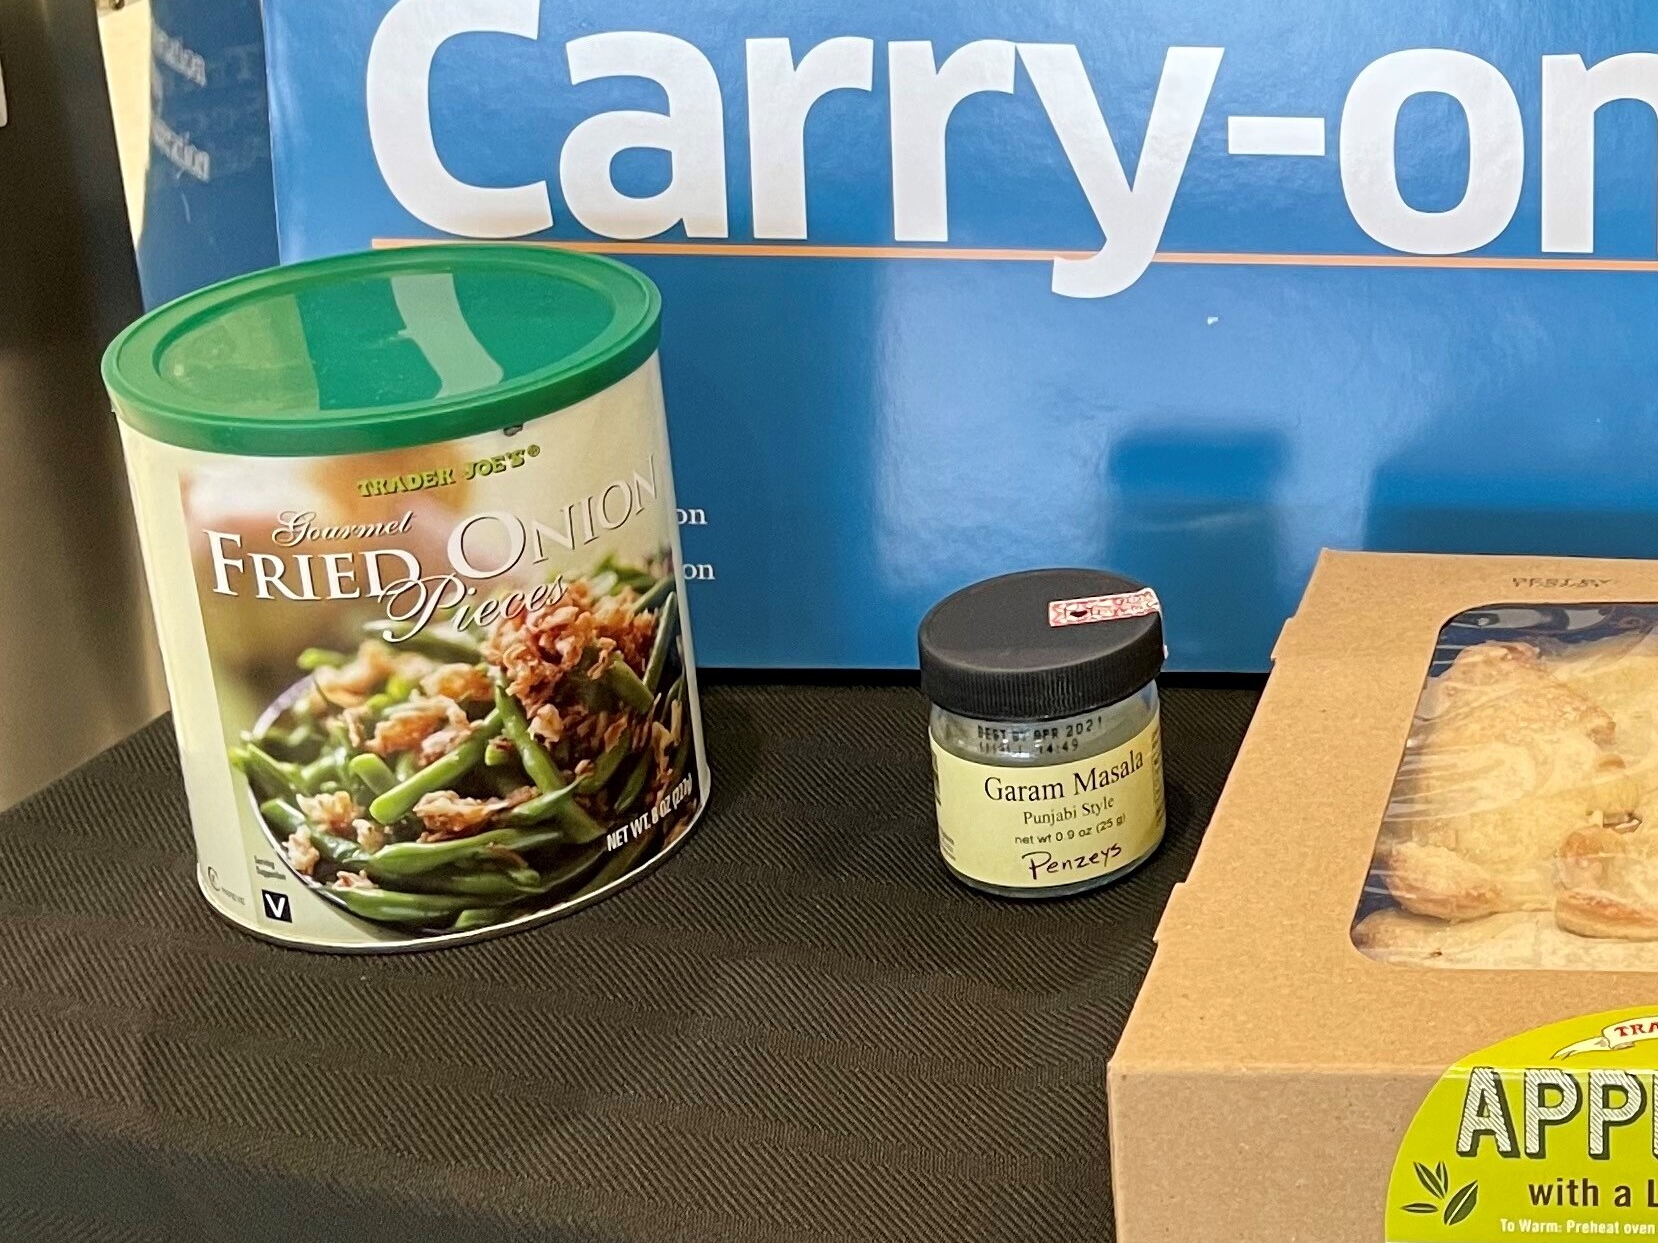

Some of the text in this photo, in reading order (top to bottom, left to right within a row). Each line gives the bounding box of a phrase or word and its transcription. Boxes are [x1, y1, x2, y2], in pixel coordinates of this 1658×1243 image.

[357, 468, 455, 498] TRADER
[202, 453, 659, 601] FRIED ONION
[271, 510, 417, 548] Gourmet
[377, 571, 570, 643] Pieces
[1033, 727, 1058, 740] APR
[984, 776, 1065, 801] Garam
[1073, 750, 1144, 796] Masala
[1023, 796, 1115, 826] Punjabi Style
[606, 825, 628, 852] NET
[630, 812, 651, 839] WT.
[1015, 834, 1034, 844] net
[1037, 834, 1052, 843] wt
[1078, 827, 1092, 837] oz
[1021, 842, 1122, 880] Penzeys
[1528, 1177, 1600, 1209] with
[1614, 1185, 1632, 1208] a
[1500, 1218, 1515, 1233] To
[1519, 1219, 1562, 1233] Warm:
[1566, 1219, 1619, 1234] Preheat
[1624, 1222, 1655, 1235] oven
